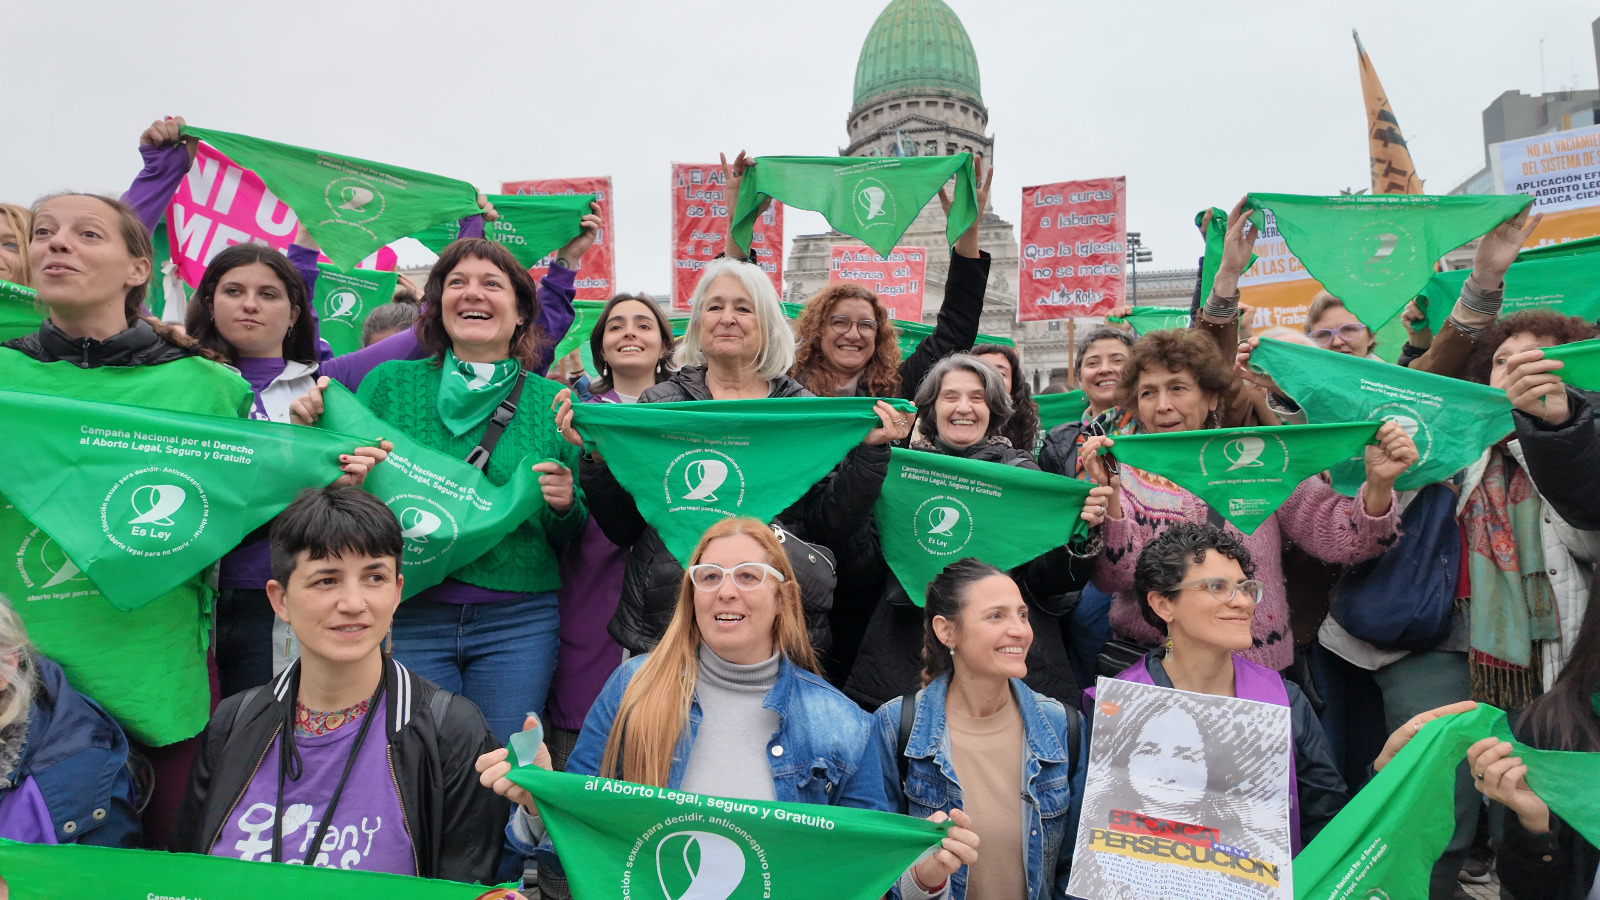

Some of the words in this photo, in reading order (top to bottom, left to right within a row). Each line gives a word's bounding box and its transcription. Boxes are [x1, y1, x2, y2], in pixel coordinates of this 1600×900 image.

[1527, 144, 1539, 158] NO
[1543, 142, 1553, 156] AL
[1554, 133, 1600, 153] VACIAMIE
[1522, 161, 1539, 176] DEL
[1541, 155, 1581, 173] SISTEMA
[1583, 151, 1595, 166] DE
[1516, 172, 1581, 191] APLICACIÓN
[686, 186, 724, 201] Legal
[1536, 183, 1579, 197] ABORTO
[1034, 192, 1062, 207] Los
[1069, 190, 1112, 203] curas
[688, 206, 704, 216] se
[1041, 217, 1049, 227] a
[1059, 214, 1115, 228] laburar
[691, 231, 721, 242] Abajo
[703, 246, 712, 255] el
[843, 251, 851, 262] A
[855, 252, 870, 261] las
[1025, 244, 1054, 261] Que
[1059, 242, 1071, 256] la
[1076, 240, 1123, 256] iglesia
[841, 269, 883, 278] defensa
[894, 268, 909, 276] del
[1034, 268, 1051, 278] no
[1056, 266, 1073, 276] se
[1244, 261, 1259, 277] EN
[1263, 259, 1285, 275] LAS
[877, 284, 905, 295] Legal
[1274, 305, 1307, 314] Plenario
[81, 425, 131, 439] Campaña
[134, 431, 178, 443] Nacional
[181, 438, 199, 446] por
[201, 440, 210, 448] el
[213, 440, 254, 455] Derecho
[80, 437, 90, 445] al
[92, 438, 128, 449] Aborto
[132, 442, 162, 453] Legal,
[166, 446, 201, 457] Seguro
[204, 451, 210, 459] y
[213, 452, 251, 465] Gratuito
[412, 464, 445, 482] Nacional
[445, 480, 458, 488] por
[902, 465, 930, 475] Campaña
[931, 471, 957, 480] Nacional
[119, 473, 134, 484] para
[200, 494, 209, 508] para
[408, 471, 431, 487] Legal,
[433, 482, 458, 498] Seguro
[907, 473, 928, 482] Aborto
[929, 477, 947, 486] Legal,
[949, 481, 969, 490] Seguro
[976, 487, 1002, 497] Gratuito
[131, 526, 147, 536] Es
[150, 528, 171, 541] Ley
[126, 546, 143, 556] legal
[408, 544, 424, 554] Ley
[937, 539, 948, 548] Ley
[53, 592, 70, 600] legal
[585, 780, 598, 791] al
[602, 780, 654, 798] Aborto
[658, 789, 702, 807] Legal,
[707, 797, 758, 813] seguro
[761, 807, 770, 820] y
[775, 809, 834, 830] Gratuito
[1108, 810, 1217, 842] BRONCA
[626, 838, 643, 868] sexual
[642, 823, 663, 842] para
[664, 813, 705, 826] decidir,
[708, 816, 769, 870] anticonceptivo
[761, 872, 771, 899] para
[1214, 844, 1232, 852] POR
[1234, 847, 1245, 857] LA
[1336, 868, 1355, 889] Nacional
